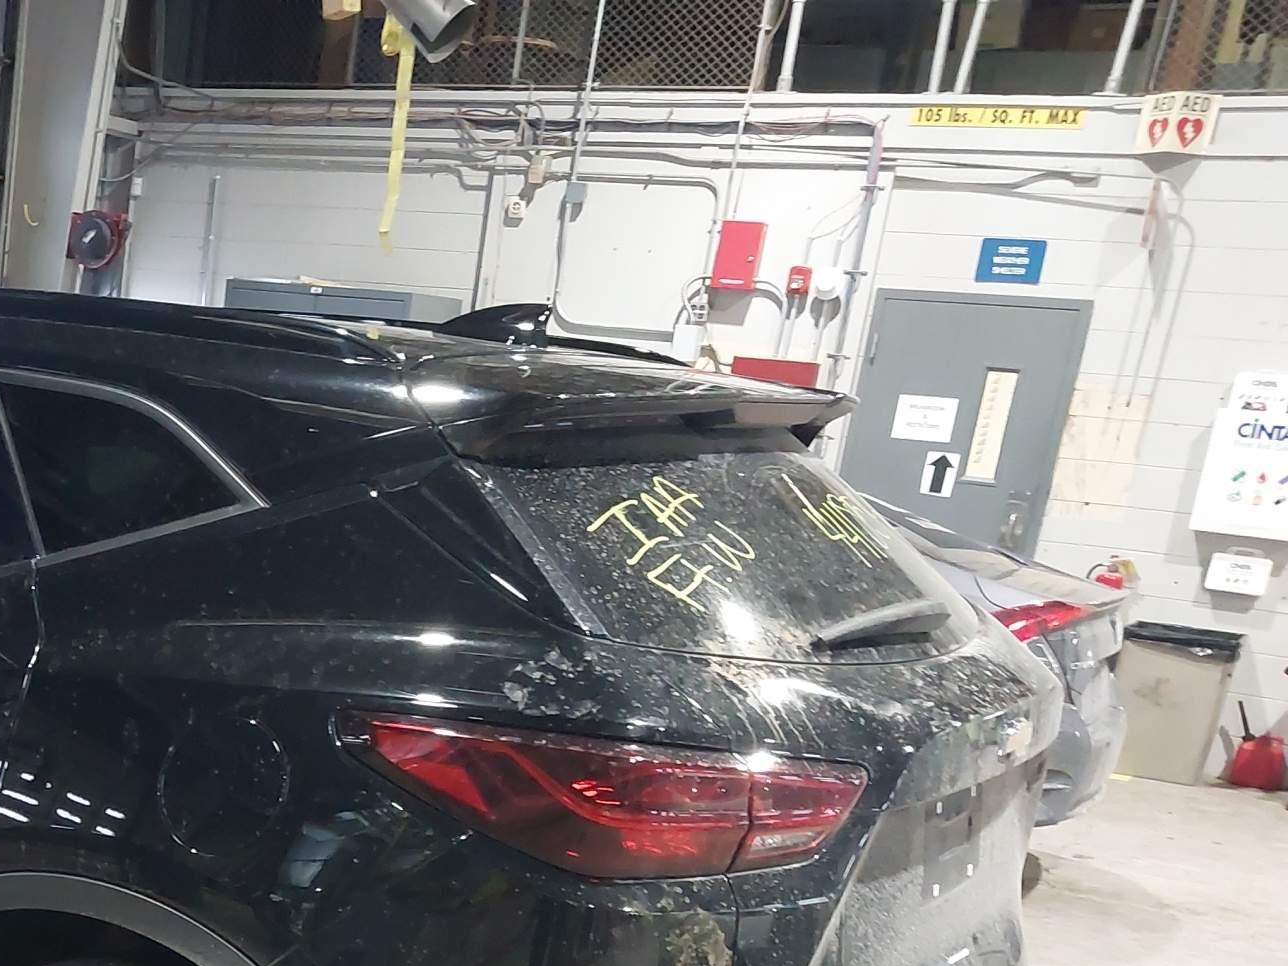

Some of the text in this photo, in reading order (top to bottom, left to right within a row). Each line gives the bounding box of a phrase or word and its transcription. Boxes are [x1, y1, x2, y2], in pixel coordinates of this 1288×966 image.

[1179, 95, 1212, 113] AED
[917, 108, 943, 122] 105
[948, 108, 973, 124] lbs.
[991, 109, 1013, 124] SQ.
[1019, 110, 1040, 125] FT.
[1046, 110, 1081, 125] MAX
